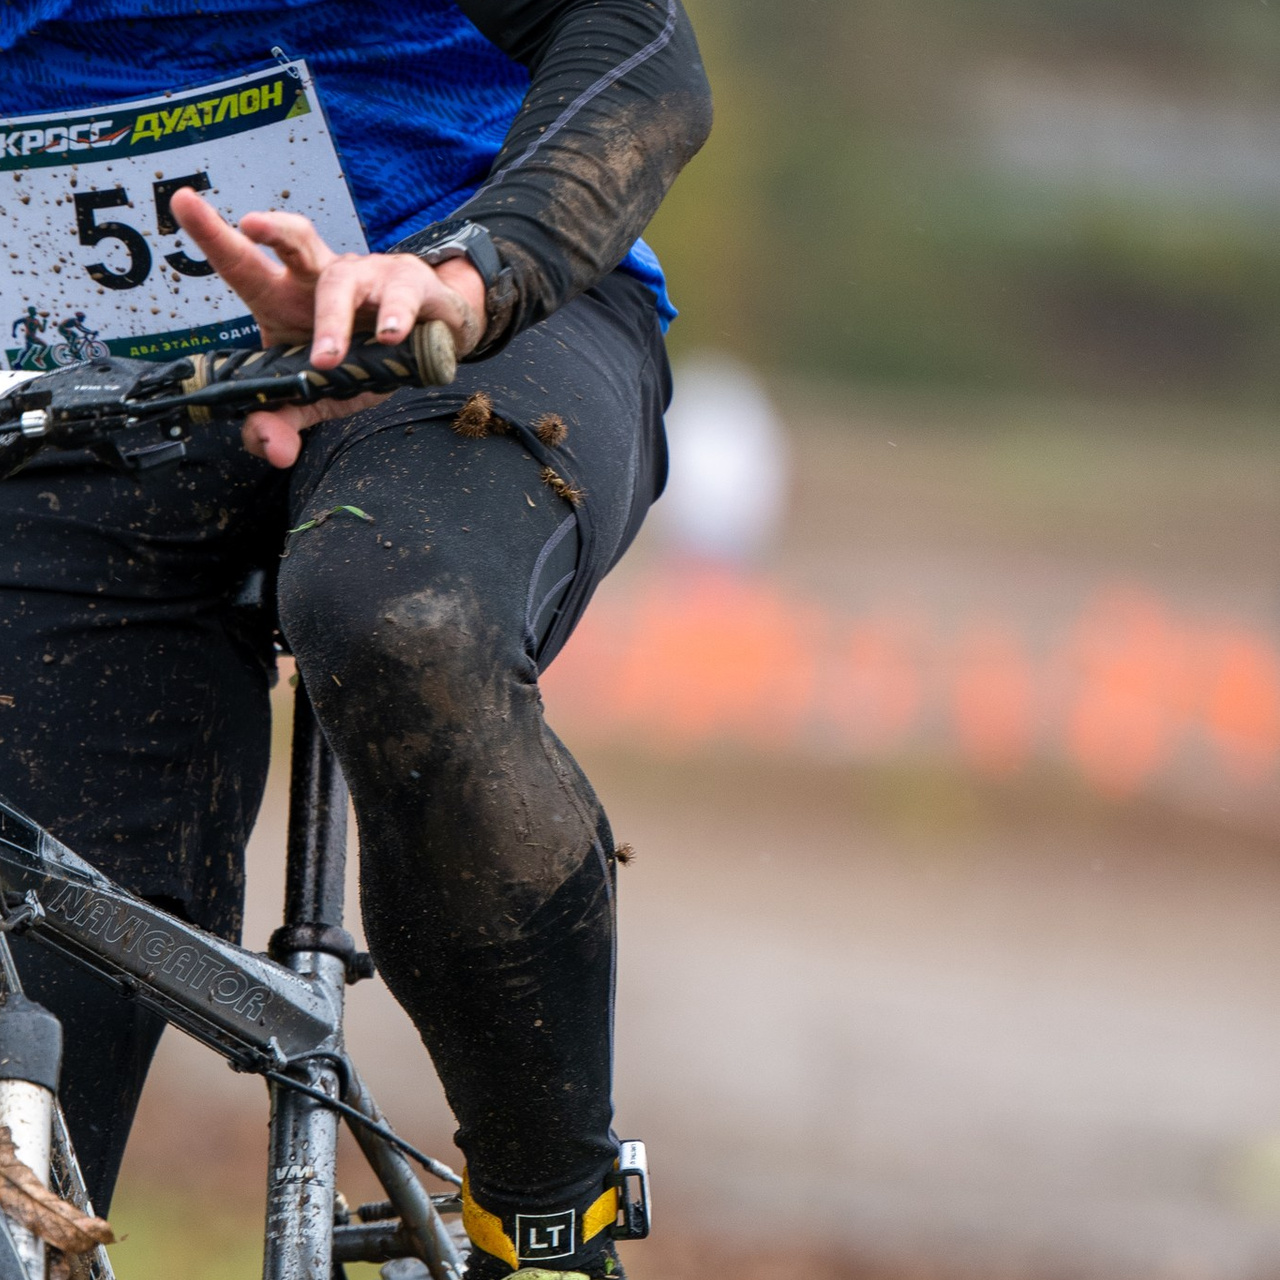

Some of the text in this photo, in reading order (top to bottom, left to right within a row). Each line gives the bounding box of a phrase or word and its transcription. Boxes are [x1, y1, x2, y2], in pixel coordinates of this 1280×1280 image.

[129, 81, 284, 146] ДУАТЛОН
[73, 171, 217, 290] 55
[129, 344, 159, 357] ДВА
[47, 883, 274, 1022] NAVIGATOR
[529, 1224, 566, 1250] LT
